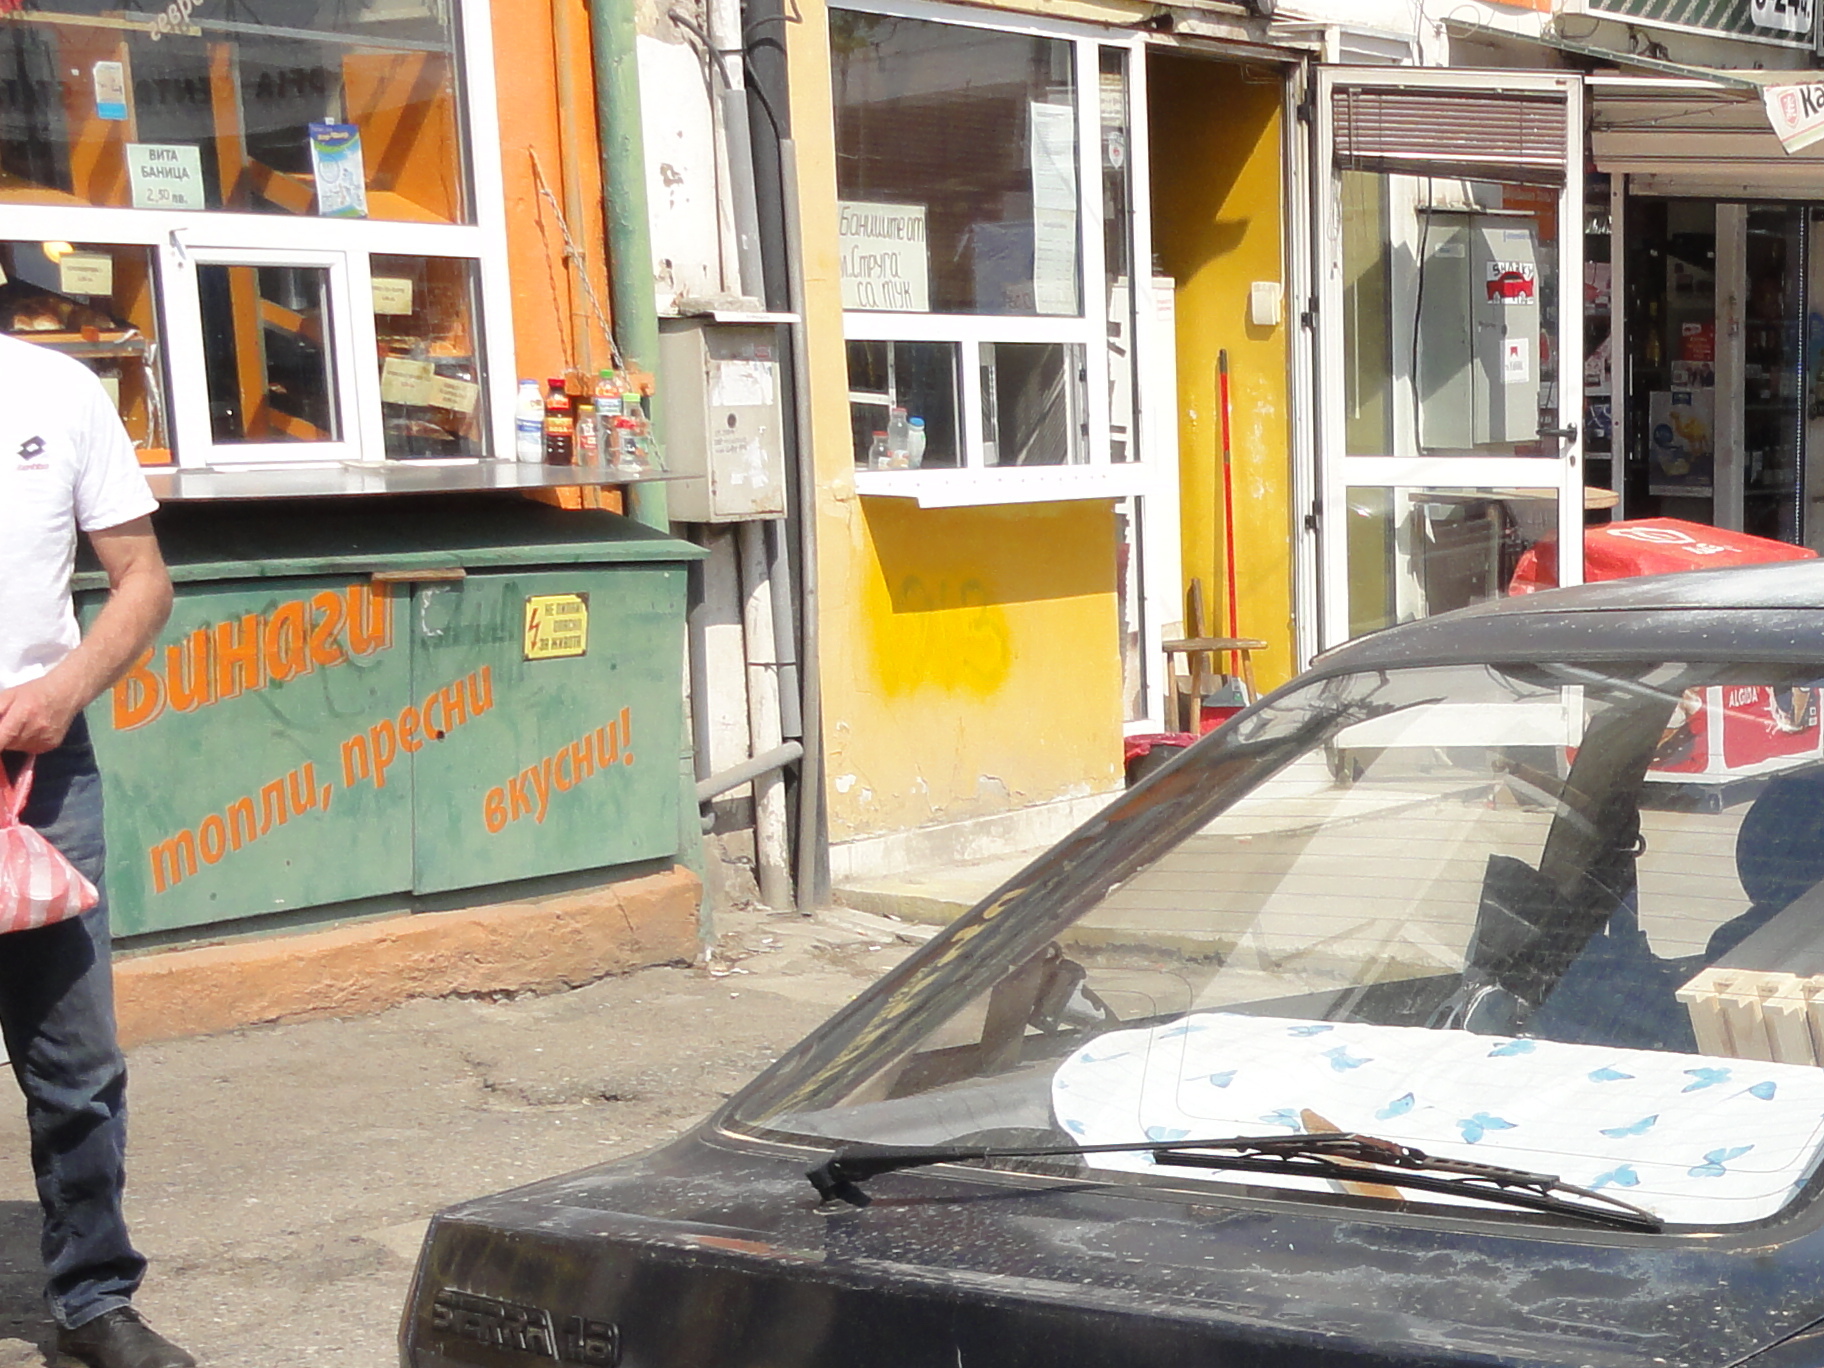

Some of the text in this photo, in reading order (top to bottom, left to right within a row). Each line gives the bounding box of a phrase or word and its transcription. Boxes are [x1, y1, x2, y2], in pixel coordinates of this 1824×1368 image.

[141, 166, 190, 182] БАНИЦА
[149, 149, 179, 162] ВИТА
[149, 664, 494, 895] топли, пресни
[482, 706, 635, 836] вкусни!
